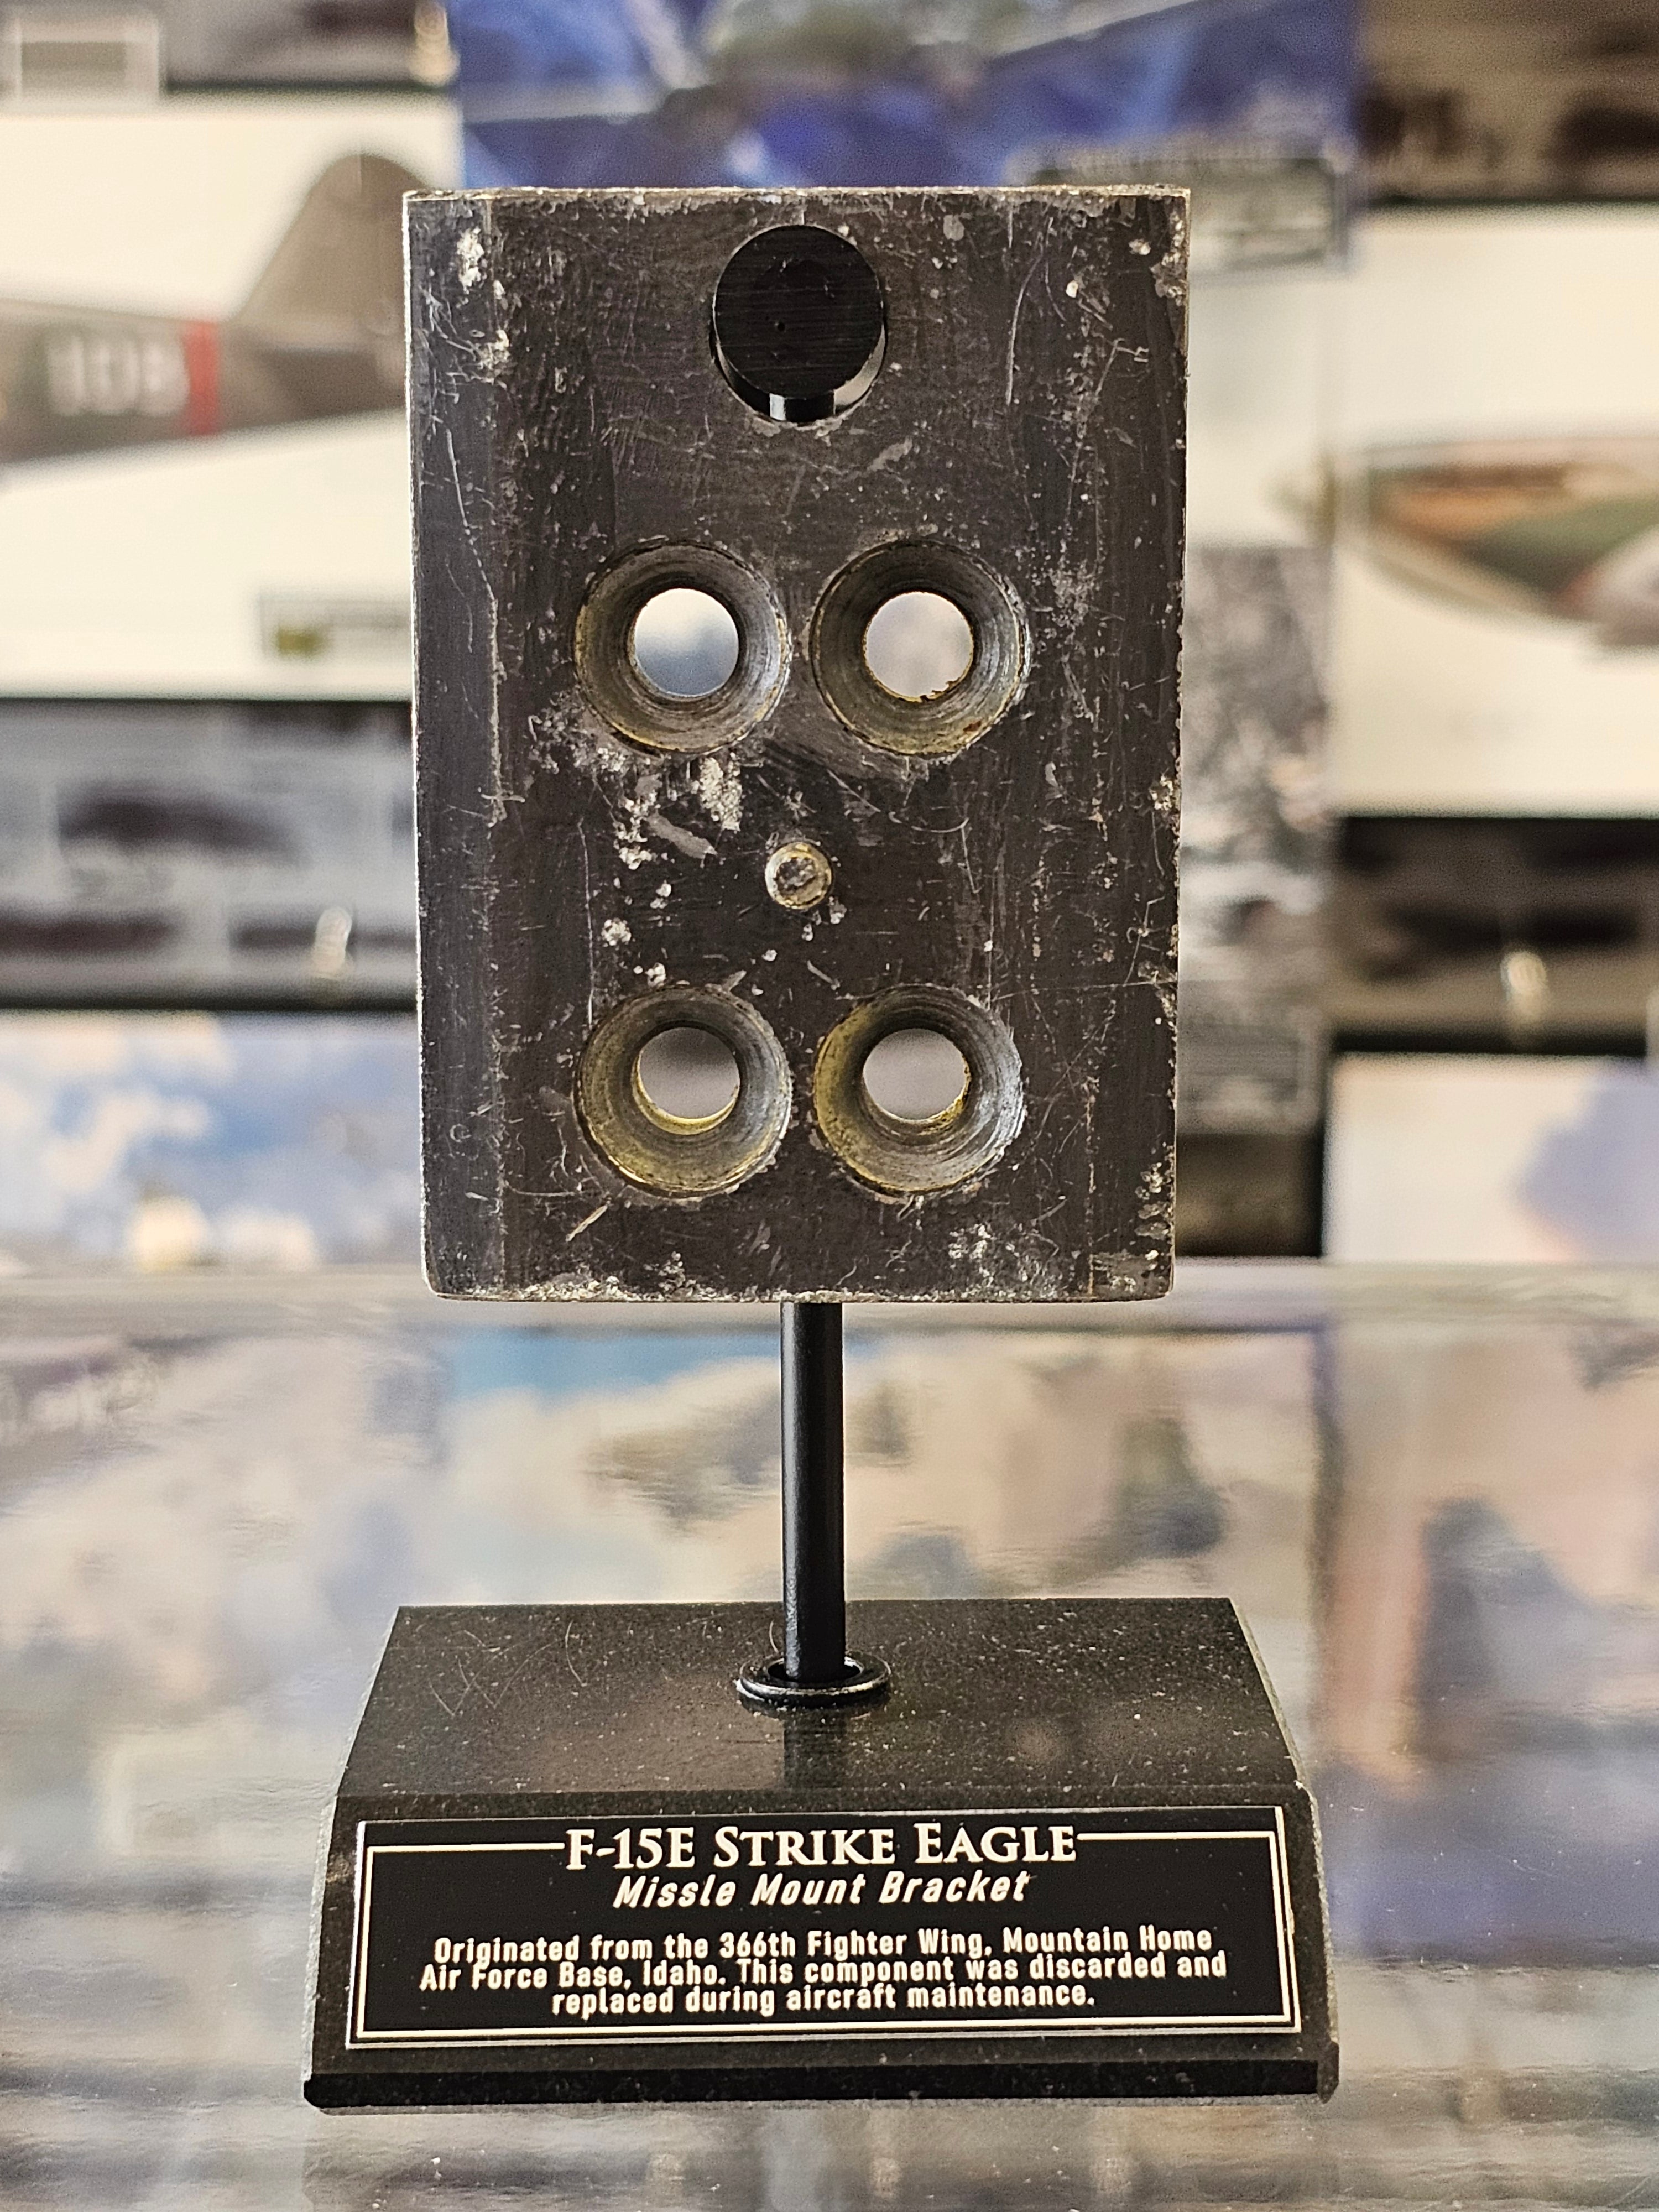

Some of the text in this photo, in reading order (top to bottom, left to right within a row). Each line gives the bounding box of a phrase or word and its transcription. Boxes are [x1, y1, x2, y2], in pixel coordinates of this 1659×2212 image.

[565, 1822, 1077, 1871] F-15E STRIKE EAGLE
[612, 1869, 1031, 1909] Missle Mount Bracket
[434, 1924, 1213, 1968] Originated from the 366th Fighter Wing, Mountain Home
[418, 1949, 1227, 1992] Air Force Base, Idaho. This component was discarded and
[551, 1980, 1095, 2021] replaced during aircraft maintenance.
